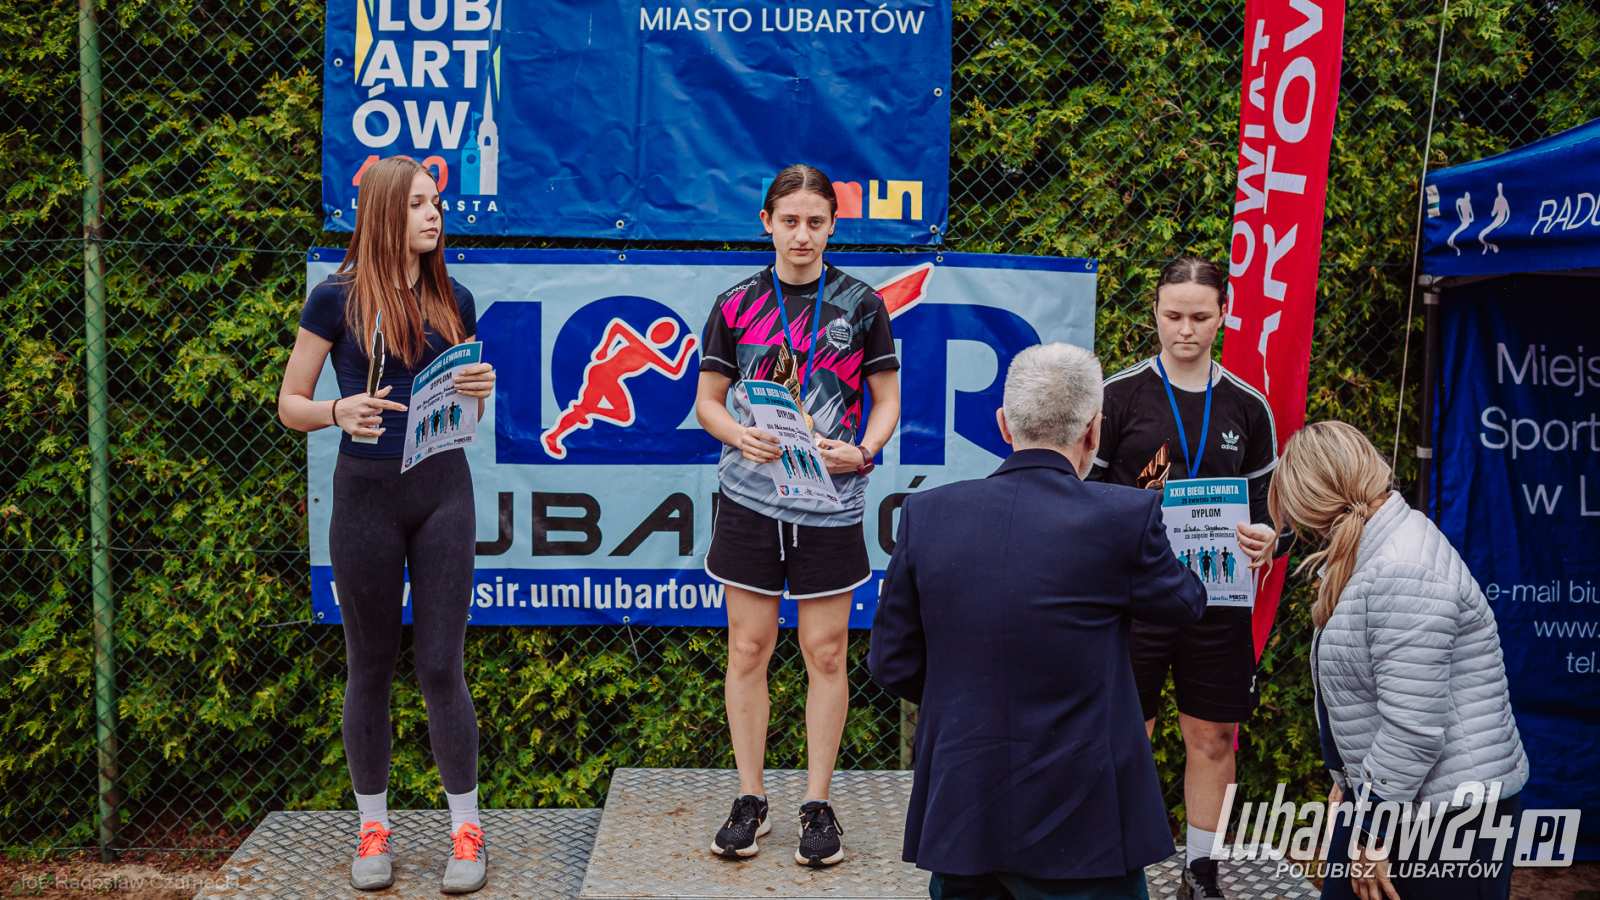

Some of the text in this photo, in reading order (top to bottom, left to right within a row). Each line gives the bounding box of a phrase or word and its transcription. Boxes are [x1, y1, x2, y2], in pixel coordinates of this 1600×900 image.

[639, 3, 925, 34] MIASTO LUBARTÓW
[361, 40, 489, 88] ART
[352, 83, 470, 150] ÓW
[1496, 342, 1600, 397] Miejs
[1479, 406, 1600, 459] Sport
[1191, 508, 1221, 519] DYPLOM
[1522, 474, 1600, 517] w L
[1486, 580, 1600, 604] e-mail biu
